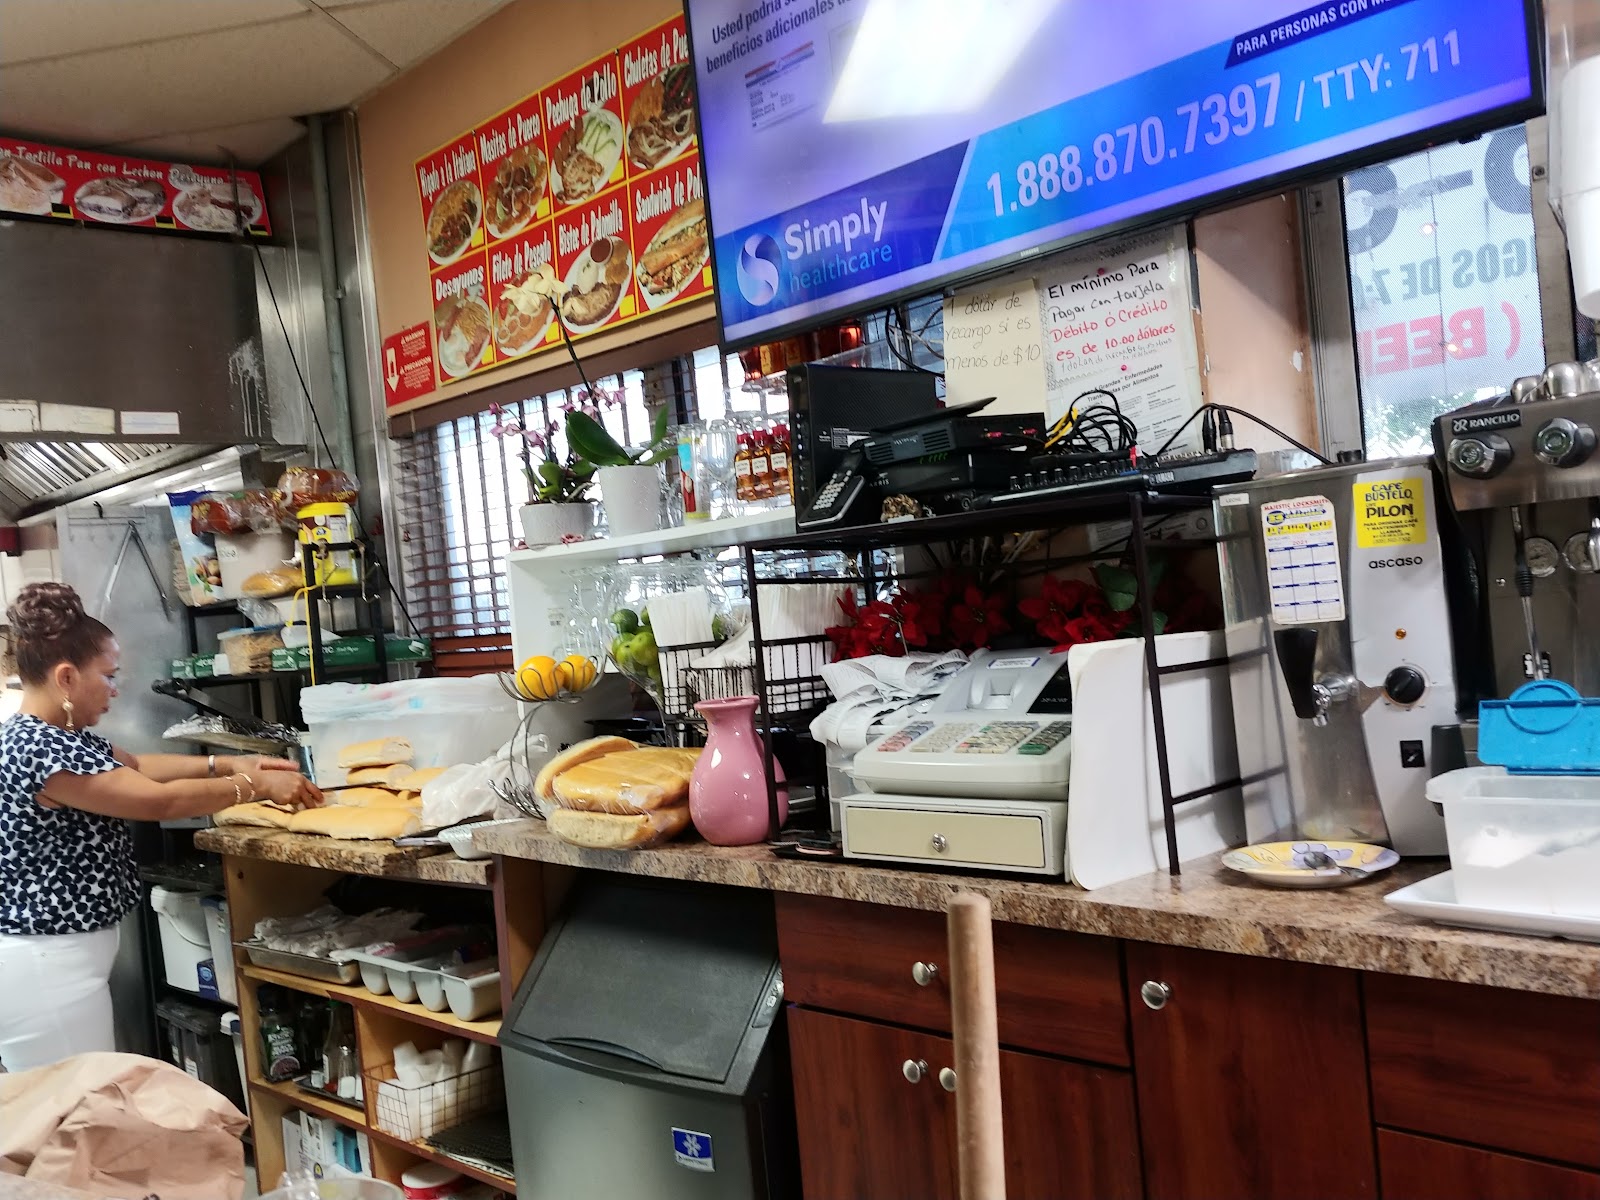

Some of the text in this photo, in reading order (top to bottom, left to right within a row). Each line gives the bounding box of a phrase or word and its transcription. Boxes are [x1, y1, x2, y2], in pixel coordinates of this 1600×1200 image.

[706, 0, 835, 74] beneficios adicionales
[712, 13, 744, 44] Usted
[1235, 0, 1369, 56] PARA PERSONAS CON
[623, 45, 658, 89] Chuletas
[660, 33, 671, 68] de
[545, 62, 617, 130] Pechuga de Pollo
[479, 112, 540, 165] Masitas de Puerco
[986, 72, 1281, 217] 1.888.870.7397
[1400, 28, 1461, 81] 711
[16, 146, 63, 166] Tortilla
[66, 154, 163, 180] Pan con Lechon
[635, 175, 672, 224] Sandwich
[674, 170, 685, 207] de
[558, 223, 580, 257] Bistec
[580, 212, 590, 246] de
[783, 196, 888, 261] Simply
[492, 229, 552, 285] Filete de Pescado
[788, 243, 893, 293] healthcare
[435, 264, 484, 301] Desayunos
[1047, 261, 1159, 299] El mínimo Para
[946, 297, 954, 317] 1
[1005, 291, 1022, 311] de
[1048, 305, 1086, 323] Pagar
[1050, 319, 1098, 343] Débito
[1118, 299, 1168, 322] Crédito
[945, 317, 1031, 349] recargo si es
[1056, 323, 1176, 361] es de 10.00 dólares
[944, 343, 1041, 370] menos de $10
[1469, 413, 1520, 428] RANCILIO
[1368, 556, 1423, 569] ascaso
